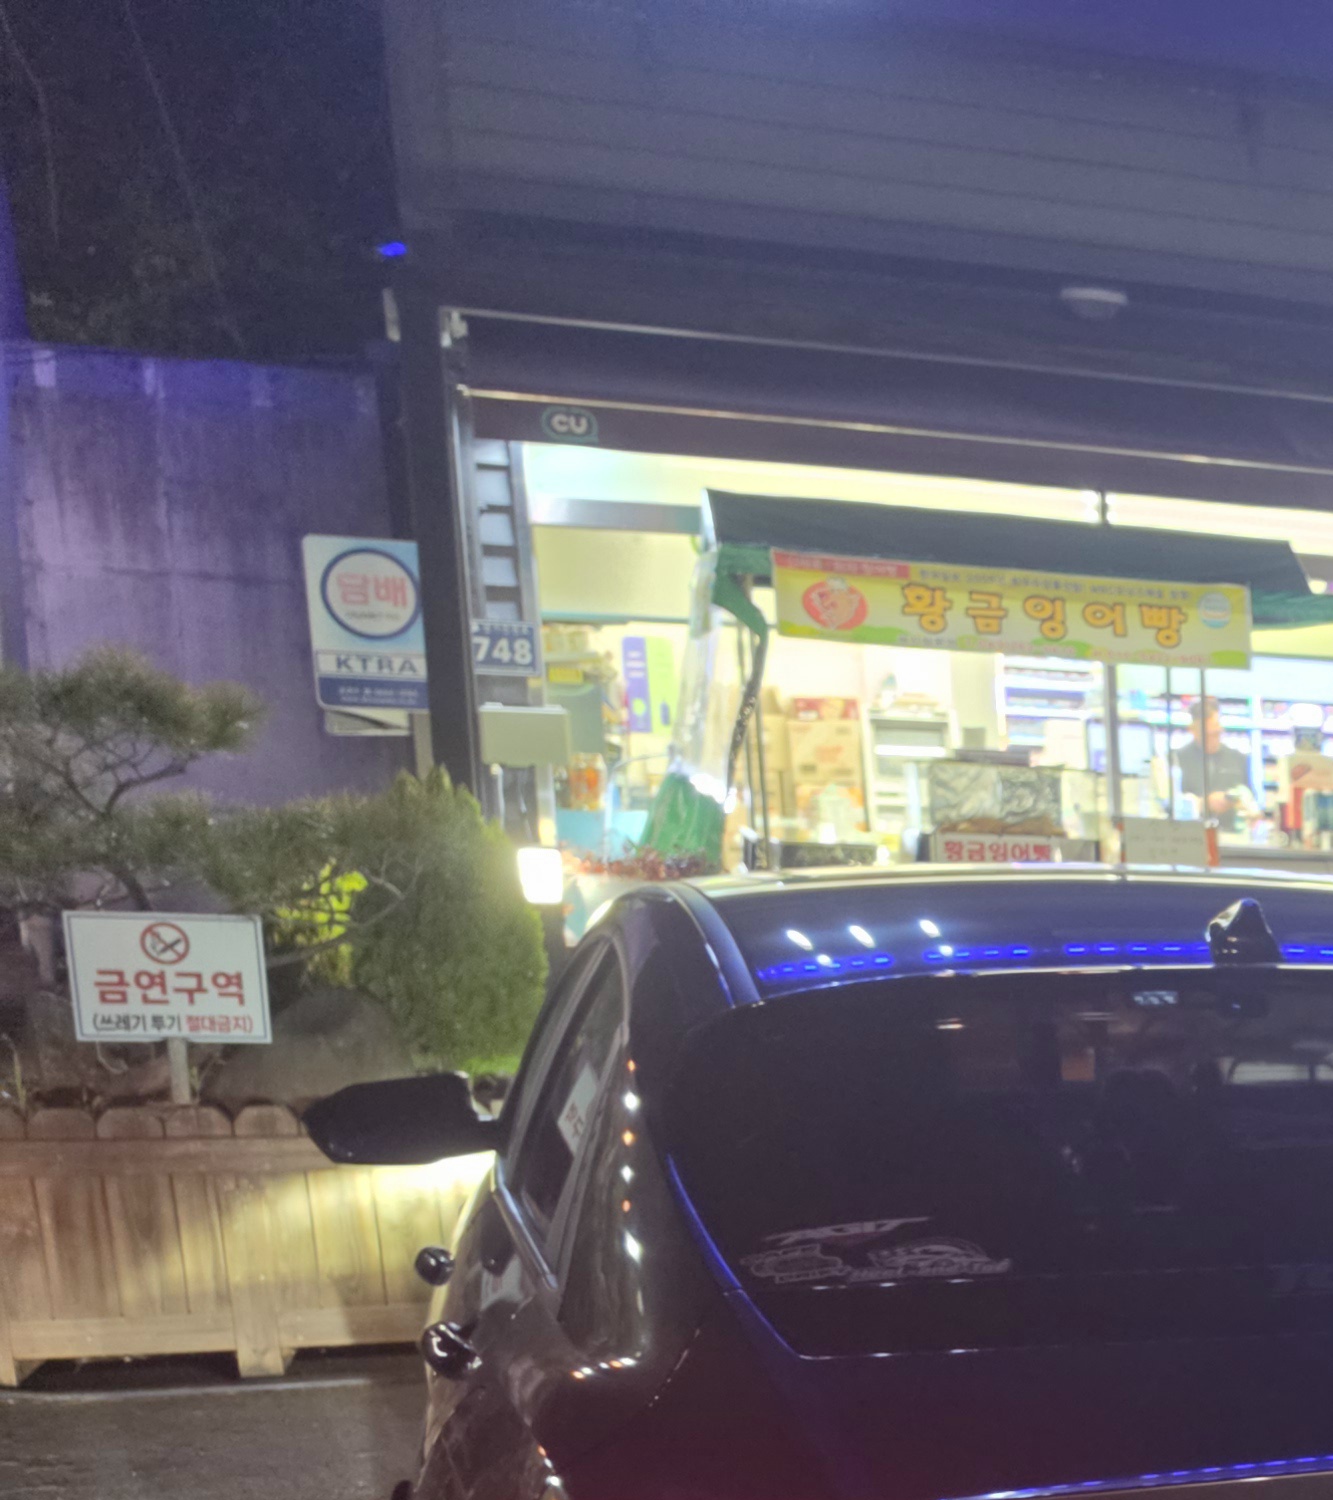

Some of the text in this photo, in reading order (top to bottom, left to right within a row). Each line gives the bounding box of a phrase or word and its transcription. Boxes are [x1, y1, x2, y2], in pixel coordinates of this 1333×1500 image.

[550, 413, 588, 435] CU
[902, 582, 1188, 649] 황금잉어빵
[472, 635, 533, 666] 748
[93, 968, 246, 1006] 금연구역
[92, 1012, 254, 1035] (쓰레기 투기 절대금지)
